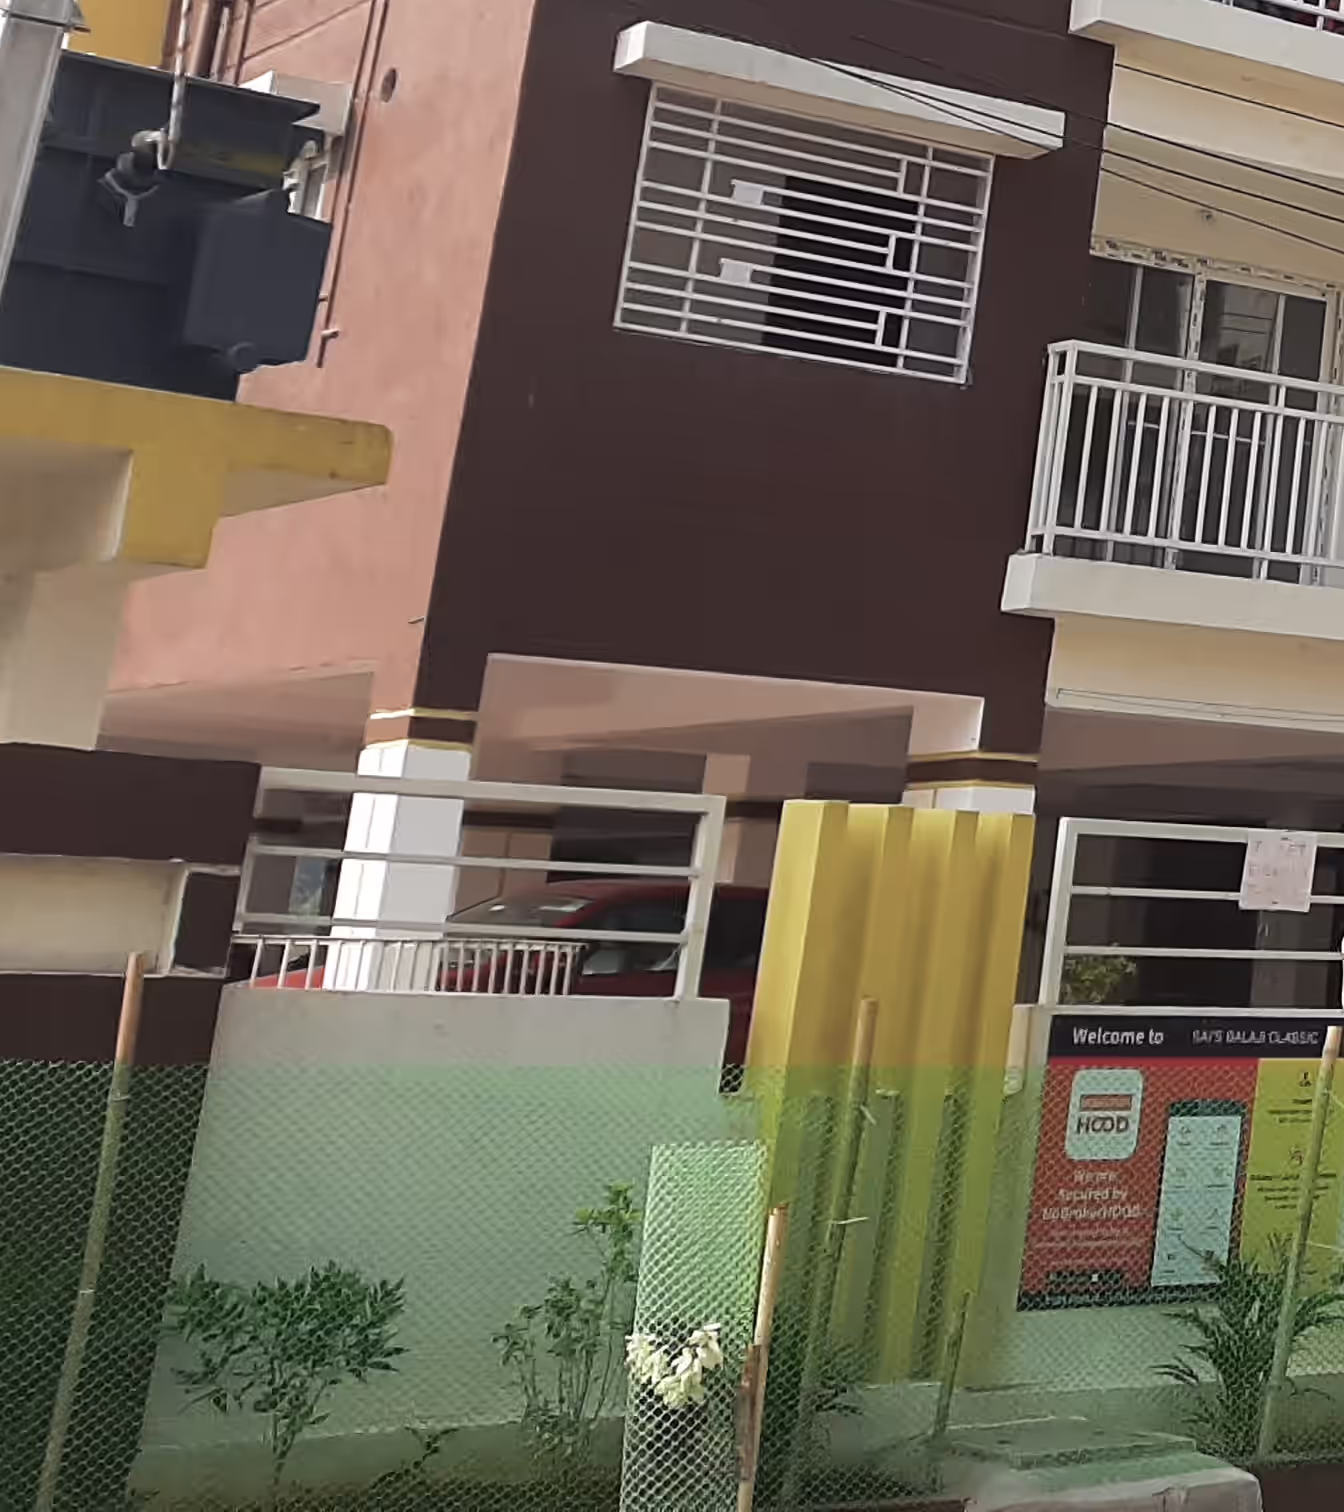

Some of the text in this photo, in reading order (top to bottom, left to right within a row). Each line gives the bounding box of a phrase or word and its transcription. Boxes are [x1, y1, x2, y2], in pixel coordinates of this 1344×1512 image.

[1072, 1026, 1165, 1045] Welcome to
[1076, 1115, 1130, 1134] HOOD
